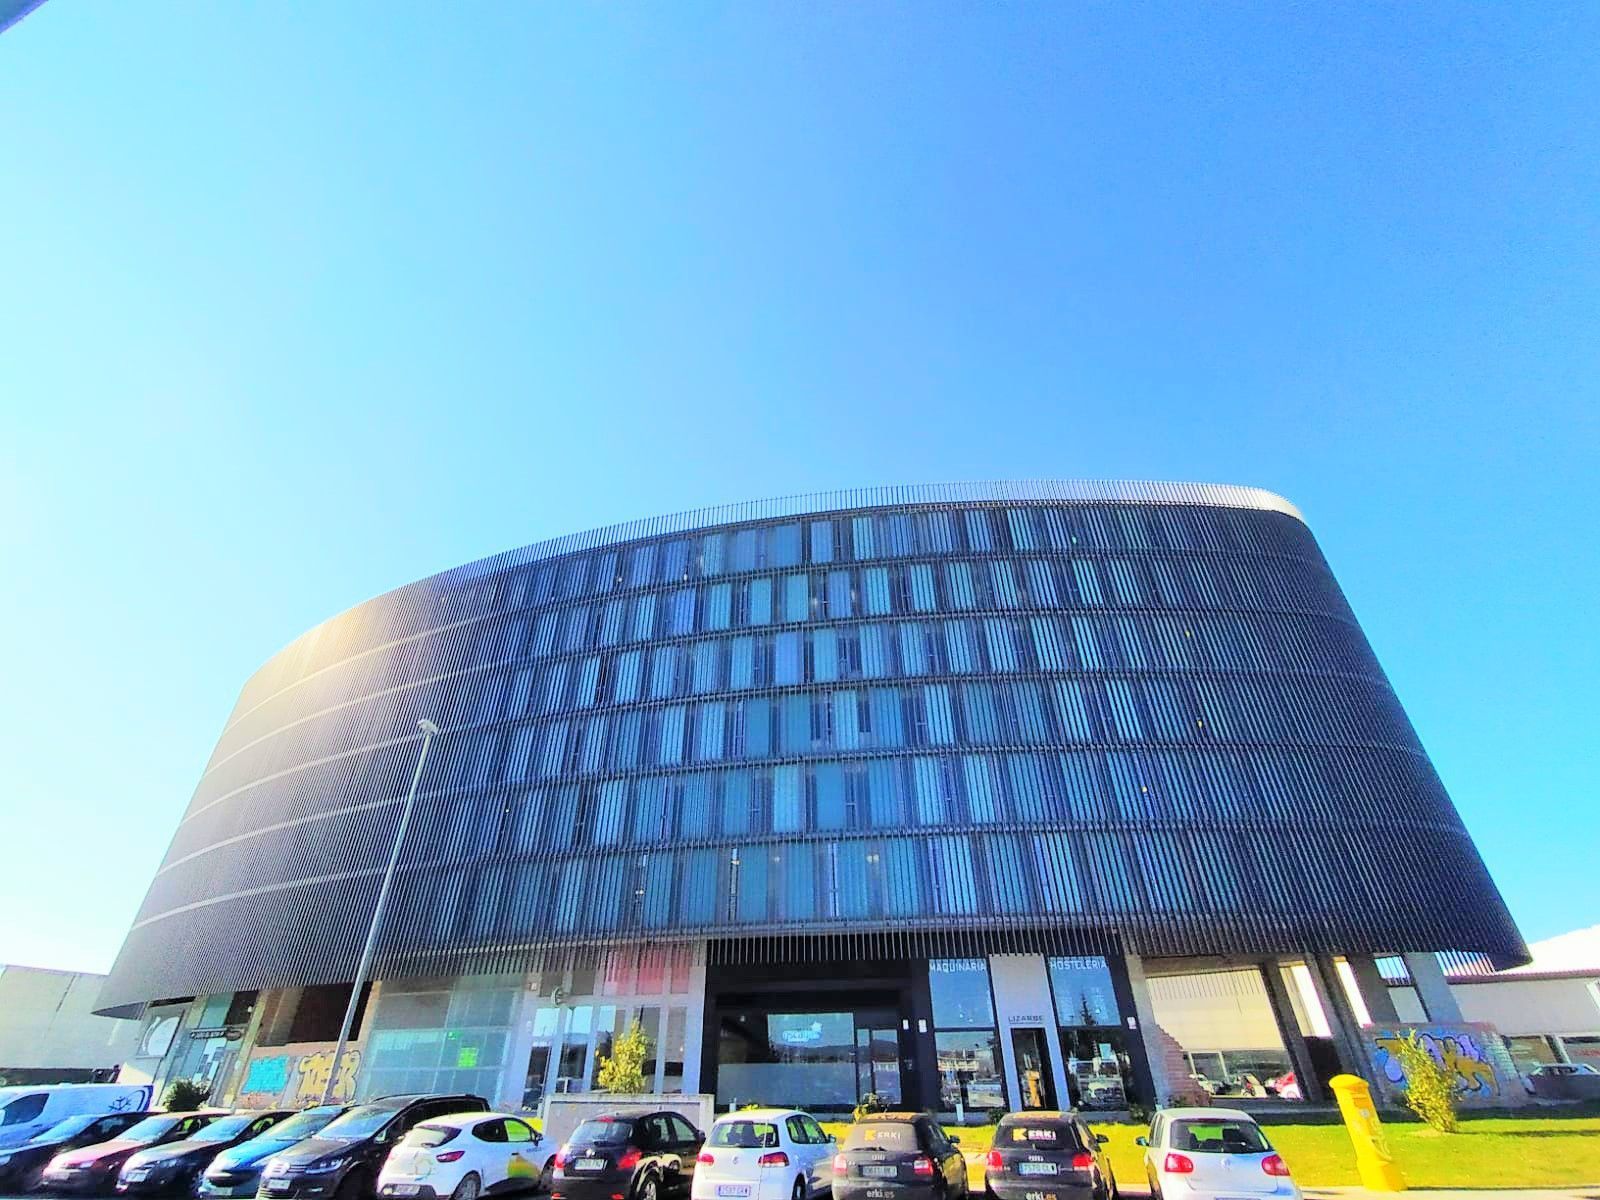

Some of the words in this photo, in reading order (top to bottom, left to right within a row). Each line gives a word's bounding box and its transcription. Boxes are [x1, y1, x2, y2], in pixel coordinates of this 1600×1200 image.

[929, 961, 986, 972] MAQUINARIA
[877, 1131, 901, 1140] ERKI
[1028, 1129, 1057, 1141] ERKI
